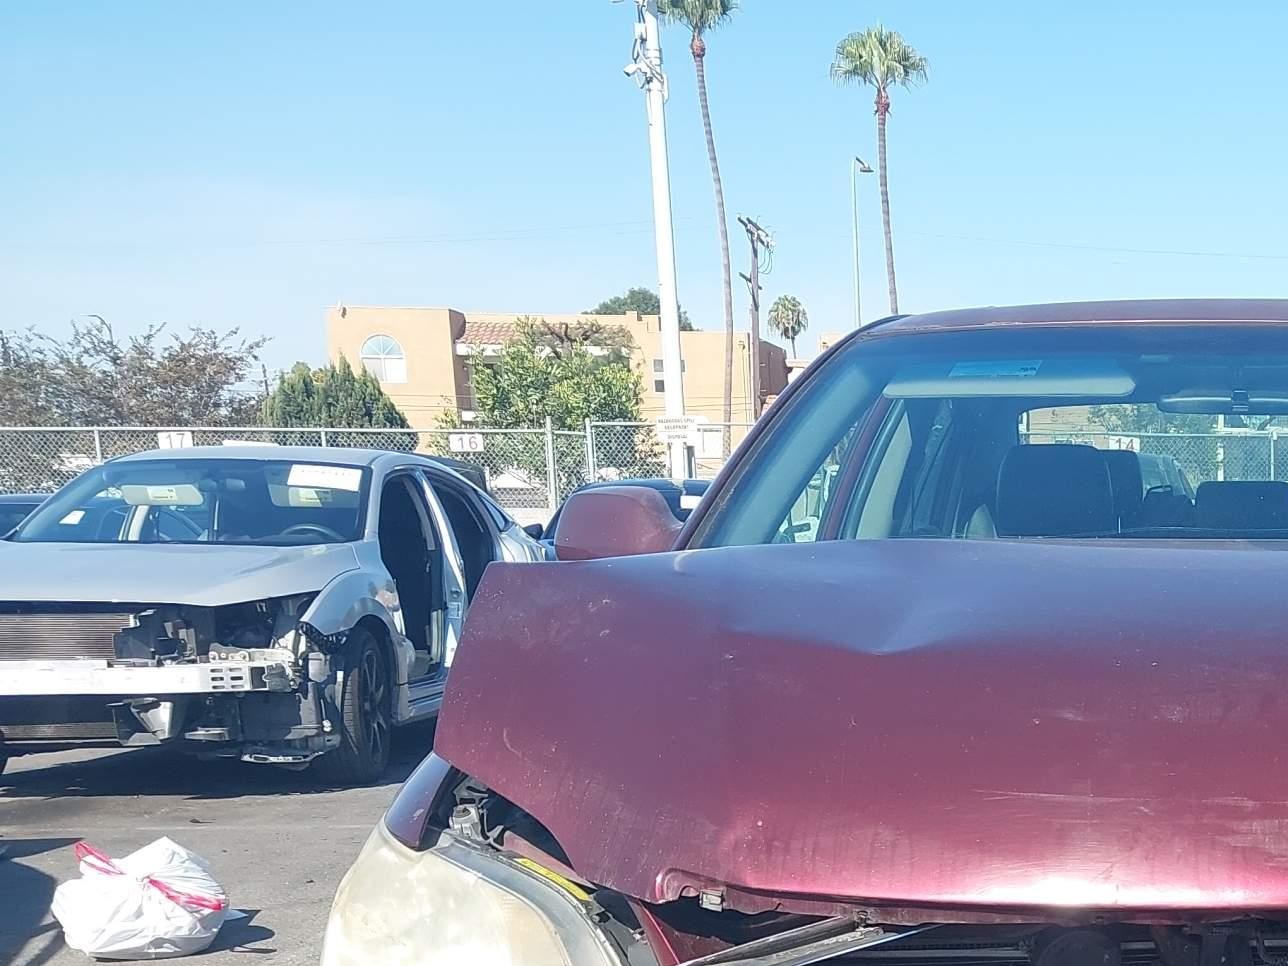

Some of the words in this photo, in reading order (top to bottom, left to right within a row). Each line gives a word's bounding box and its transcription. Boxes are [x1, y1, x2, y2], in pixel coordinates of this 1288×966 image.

[166, 432, 185, 449] 17
[458, 436, 478, 450] 16
[1115, 438, 1135, 450] 14
